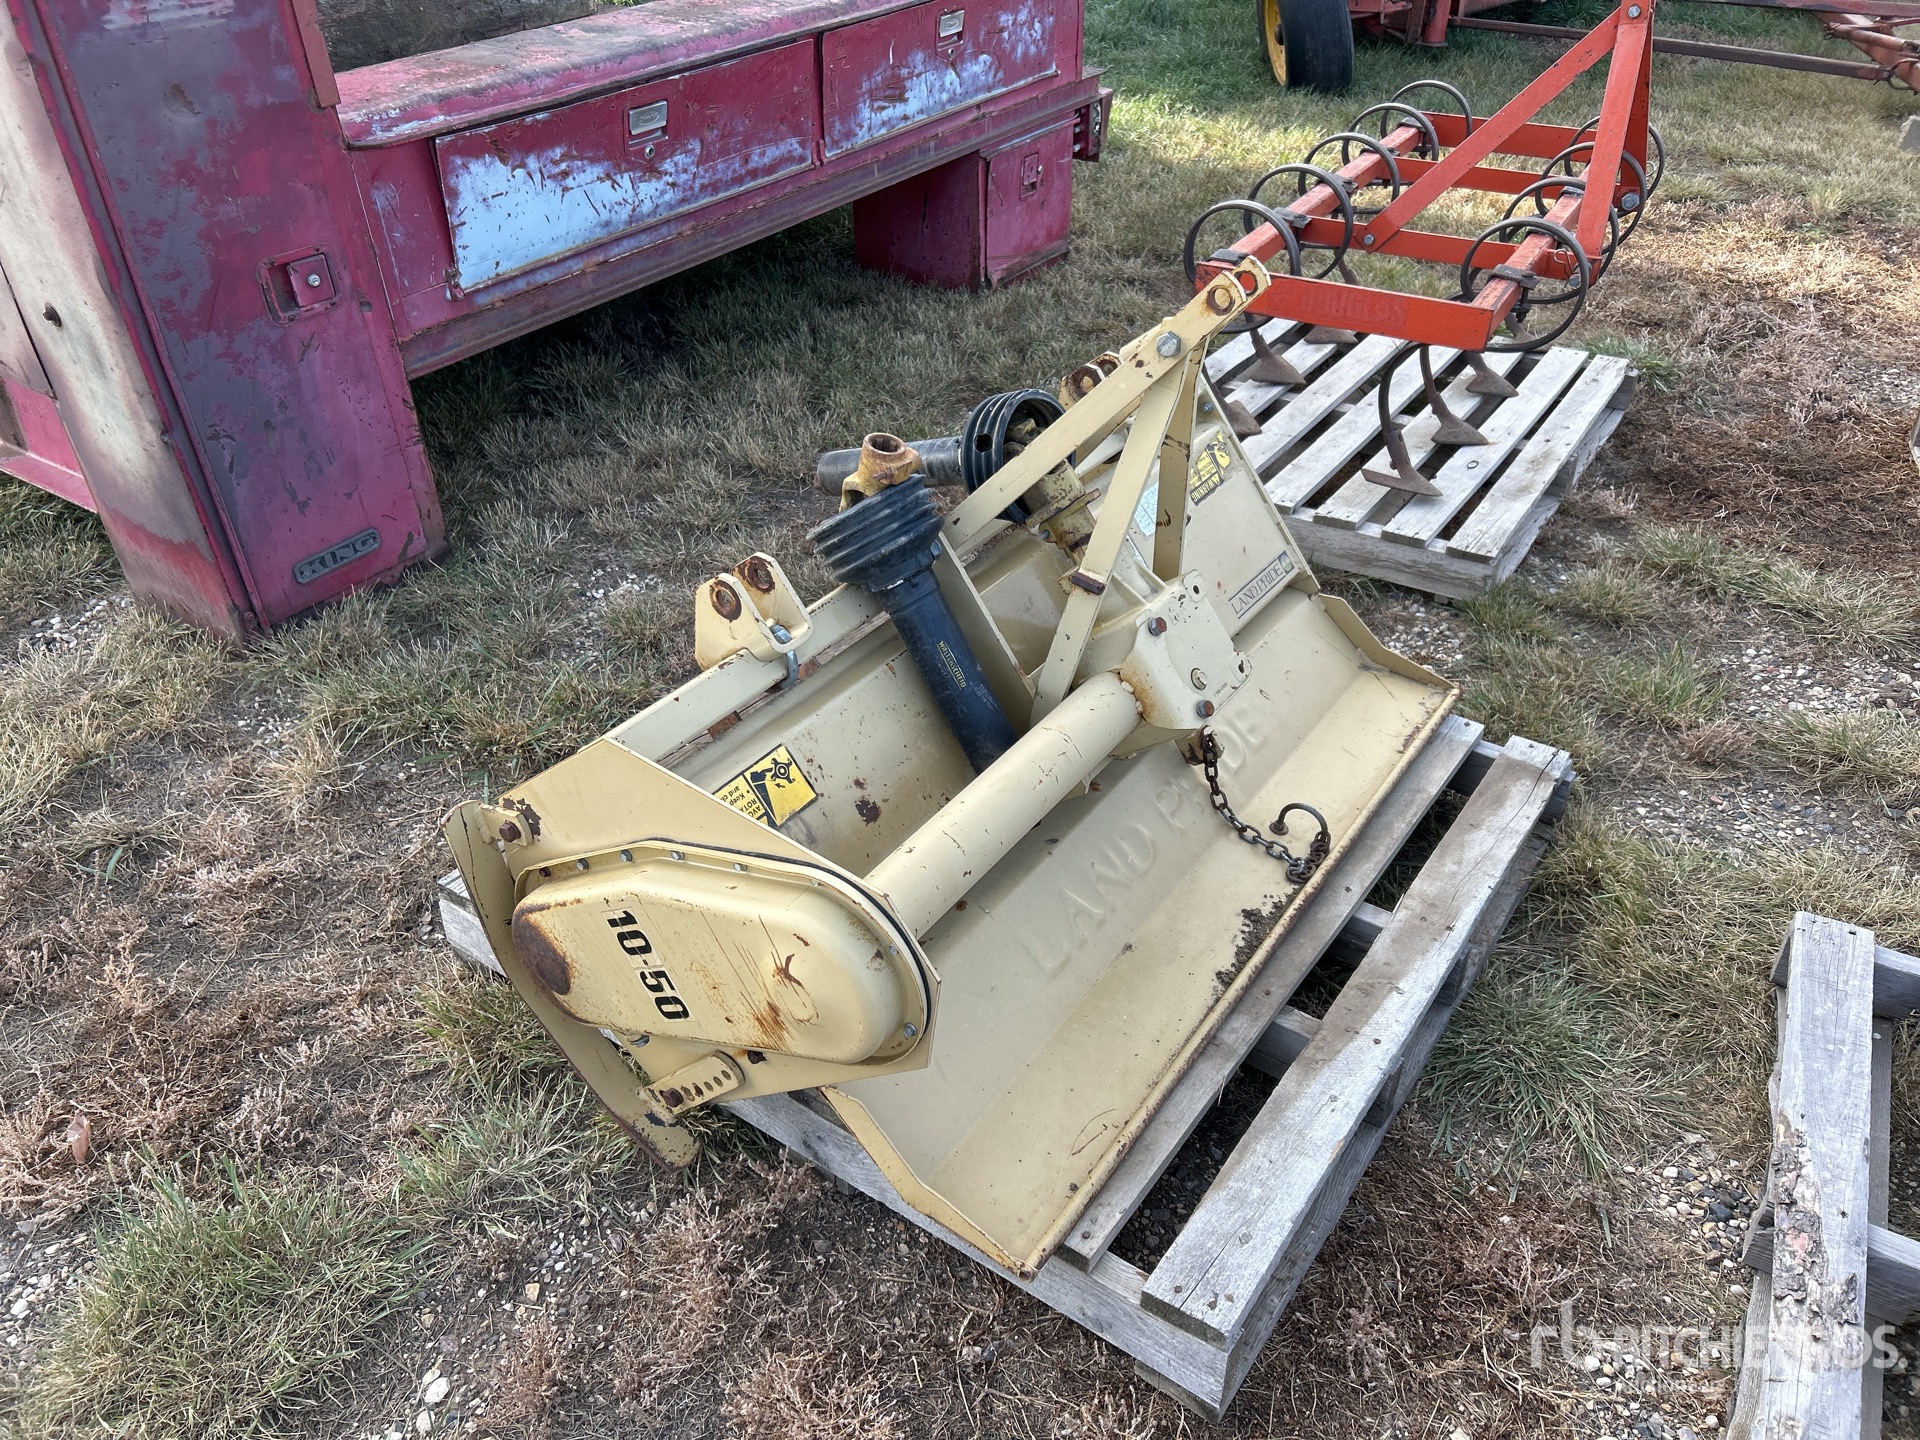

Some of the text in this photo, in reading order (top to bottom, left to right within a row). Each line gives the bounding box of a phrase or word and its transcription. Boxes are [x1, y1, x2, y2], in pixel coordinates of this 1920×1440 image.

[1190, 477, 1216, 503] WARNING
[1231, 562, 1284, 615] LAND PRIDE
[728, 785, 741, 797] and
[729, 792, 746, 806] Keep
[1018, 703, 1270, 981] LAND PRDE
[606, 910, 690, 1020] 10-50
